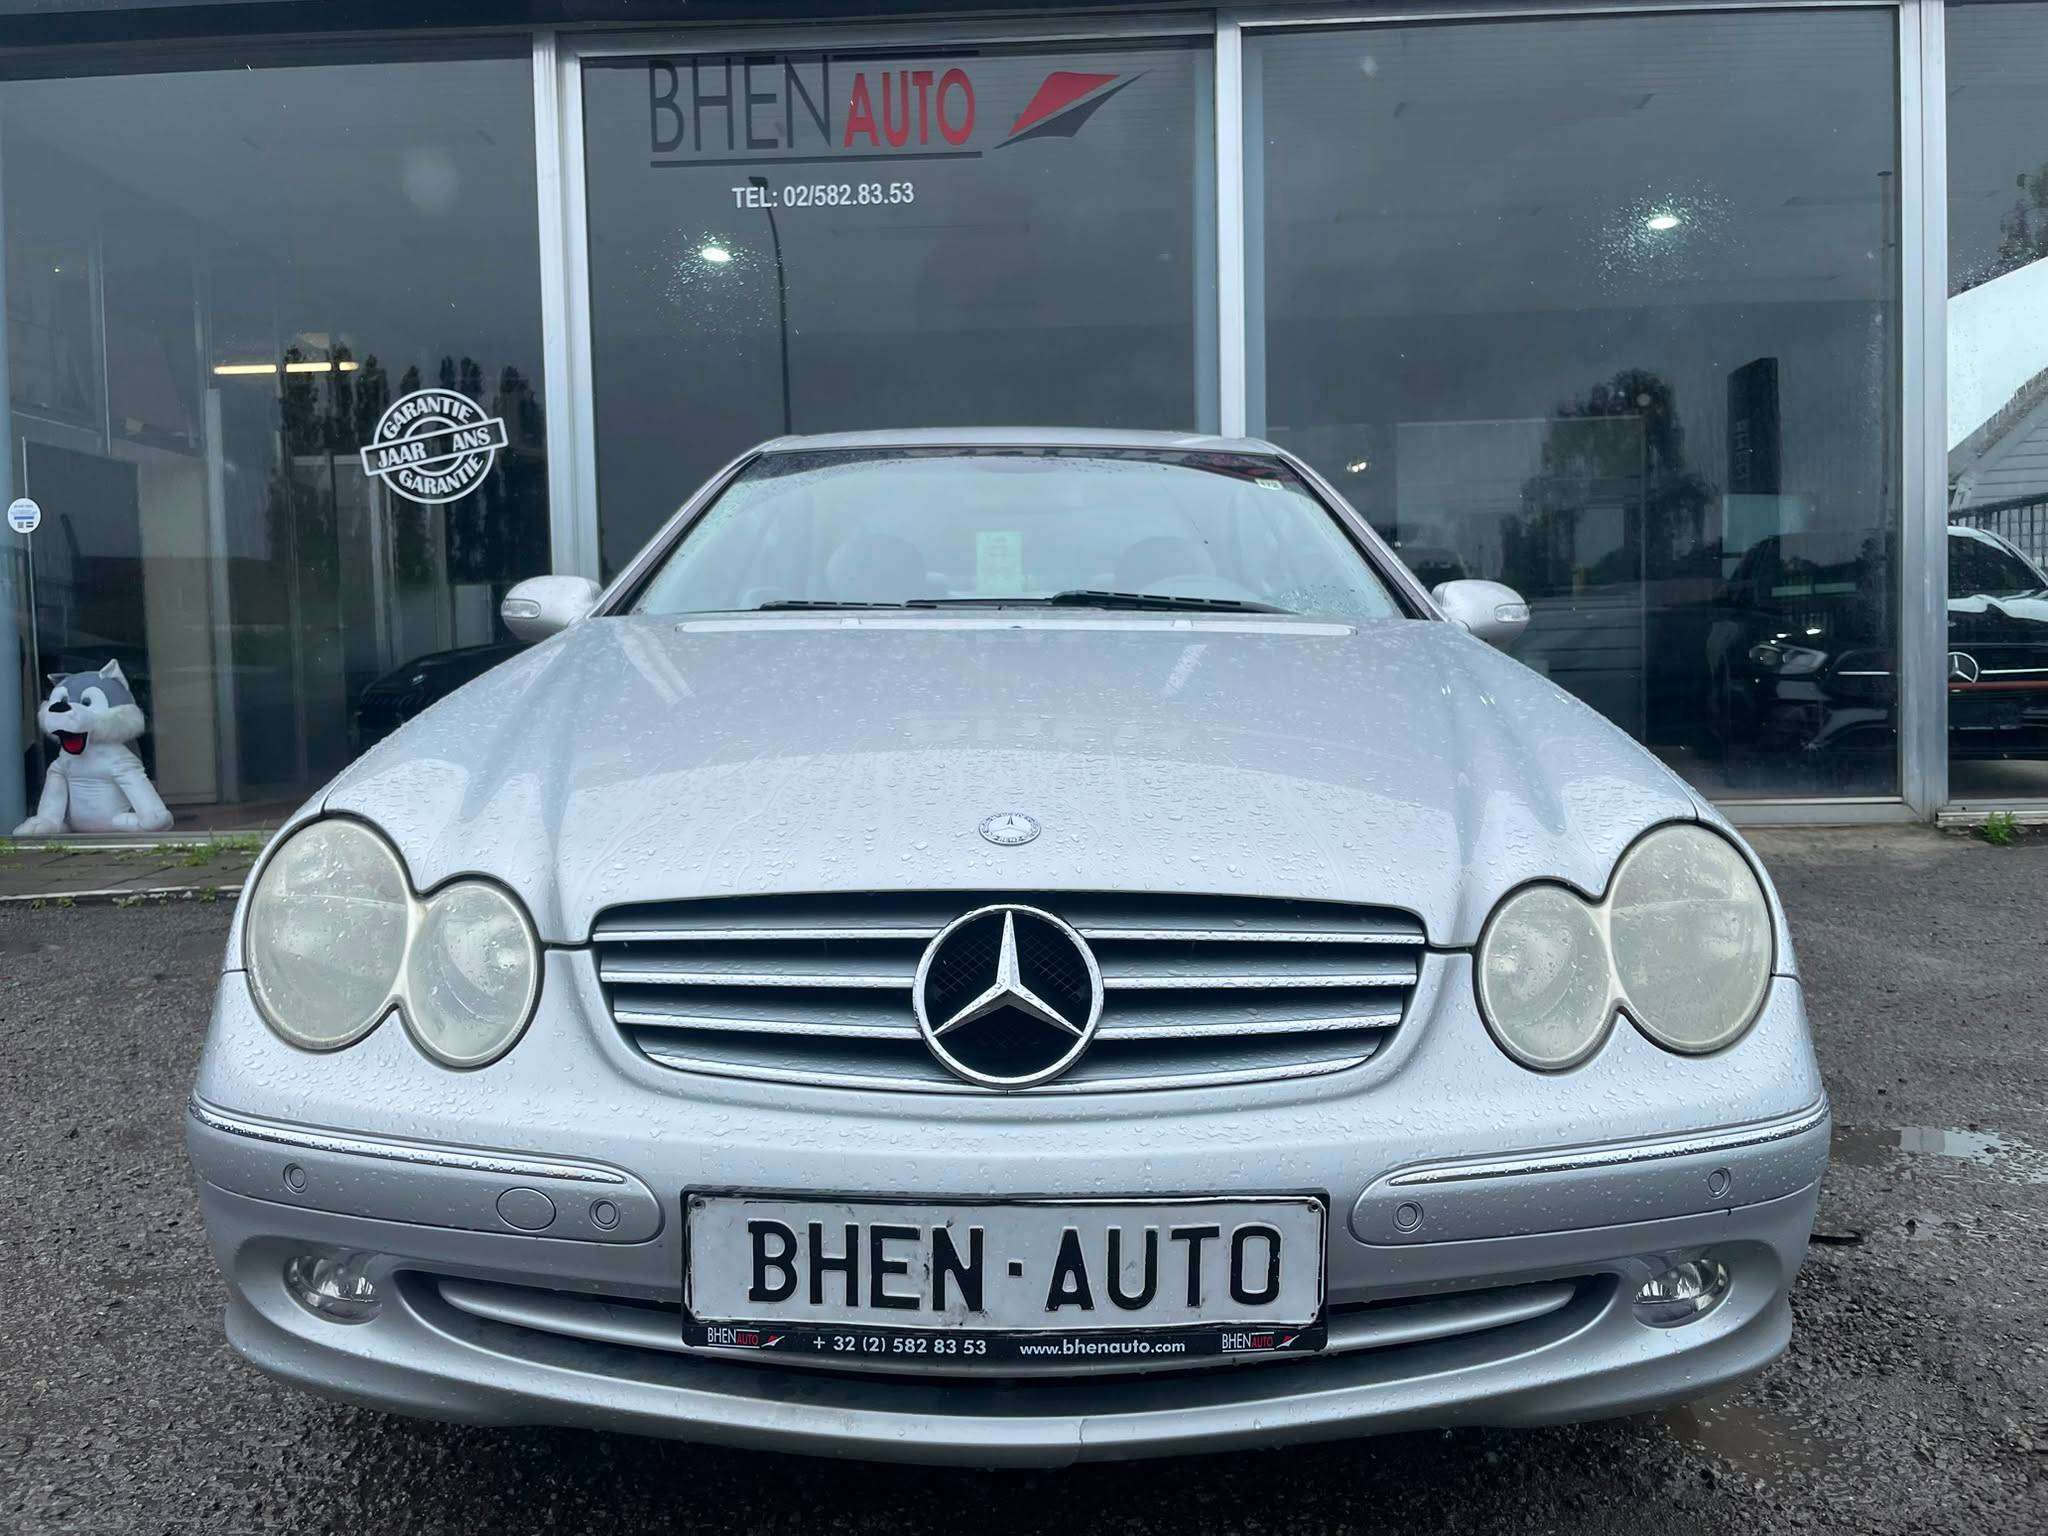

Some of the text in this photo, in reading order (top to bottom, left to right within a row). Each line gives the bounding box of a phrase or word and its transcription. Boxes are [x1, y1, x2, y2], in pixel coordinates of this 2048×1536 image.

[732, 182, 915, 208] TEL: 02/582.83.53
[382, 396, 474, 440] GARANTIE
[378, 427, 491, 469] JAAR ANS
[398, 453, 484, 495] GARANTIE
[748, 1219, 985, 1313] BHEN
[1045, 1224, 1281, 1311] AUTO
[833, 1336, 856, 1351] 32
[862, 1335, 886, 1352] (2)
[892, 1338, 927, 1354] 582
[934, 1339, 957, 1354] 83
[963, 1339, 987, 1355] 53
[1020, 1339, 1186, 1356] www.bhenauto.com
